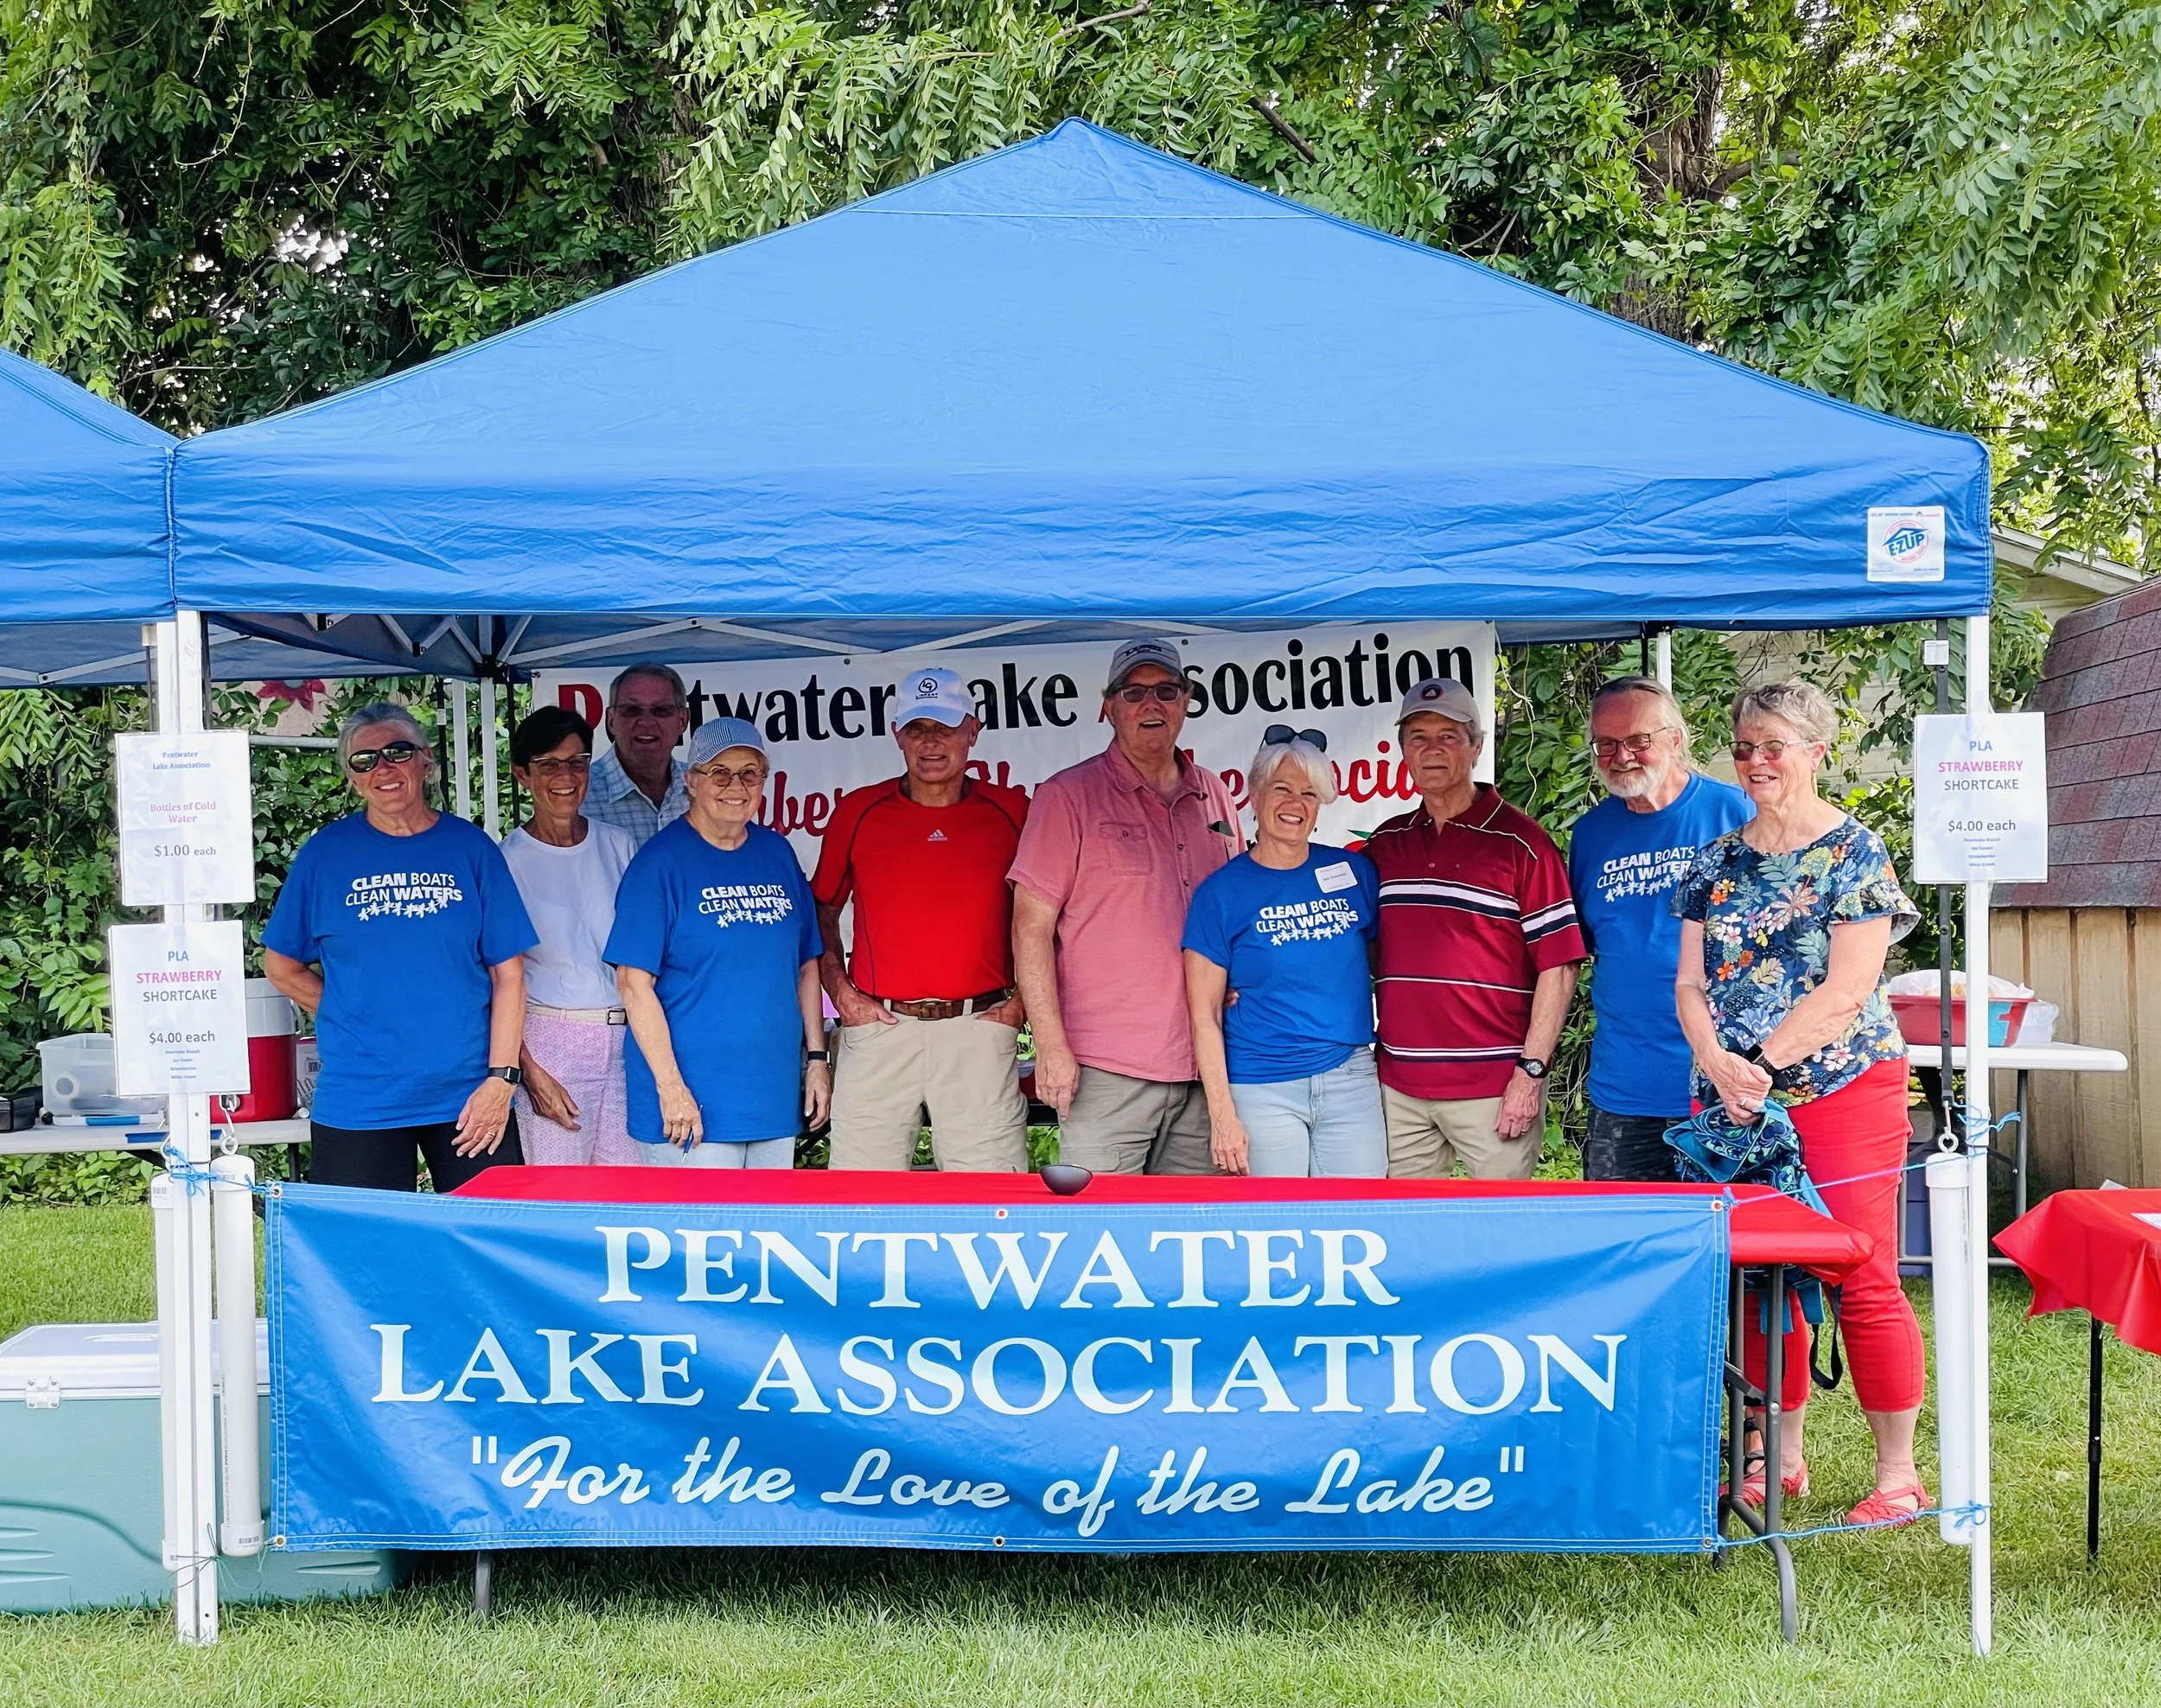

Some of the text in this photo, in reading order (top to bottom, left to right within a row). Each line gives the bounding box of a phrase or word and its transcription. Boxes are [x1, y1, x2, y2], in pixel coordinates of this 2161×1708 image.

[966, 662, 1079, 730] ake
[1098, 632, 1475, 723] sociation
[1969, 741, 1992, 751] PLA
[1938, 760, 2024, 773] STRAWBERRY
[1944, 779, 2019, 791] SHORTCAKE
[150, 800, 216, 813] Bottles of Cold
[168, 814, 198, 824] Water
[1947, 819, 2017, 832] $4.00 each
[154, 844, 216, 857] $1.00 each
[1603, 845, 1696, 874] CLEAN BOATS
[352, 872, 456, 891] CLEAN BOATS
[1597, 860, 1692, 889] CLEAN WATER
[346, 886, 463, 906] CLEAN WATERS
[701, 884, 785, 900] CLEAN BOATS
[698, 896, 793, 915] CLEAN WATERS
[1259, 898, 1349, 920] CLEAN BOATS
[1256, 910, 1359, 934] CLEAN WATERS
[168, 951, 189, 961] PLA
[136, 970, 222, 984] STRAWBERRY
[143, 989, 218, 1003] SHORTCAKE
[149, 1030, 215, 1045] $4.00 each
[595, 1225, 1400, 1310] PENTWATER
[370, 1323, 1628, 1416] LAKE ASSOCIATION
[470, 1435, 1526, 1538] "For the Love of the Lake"
